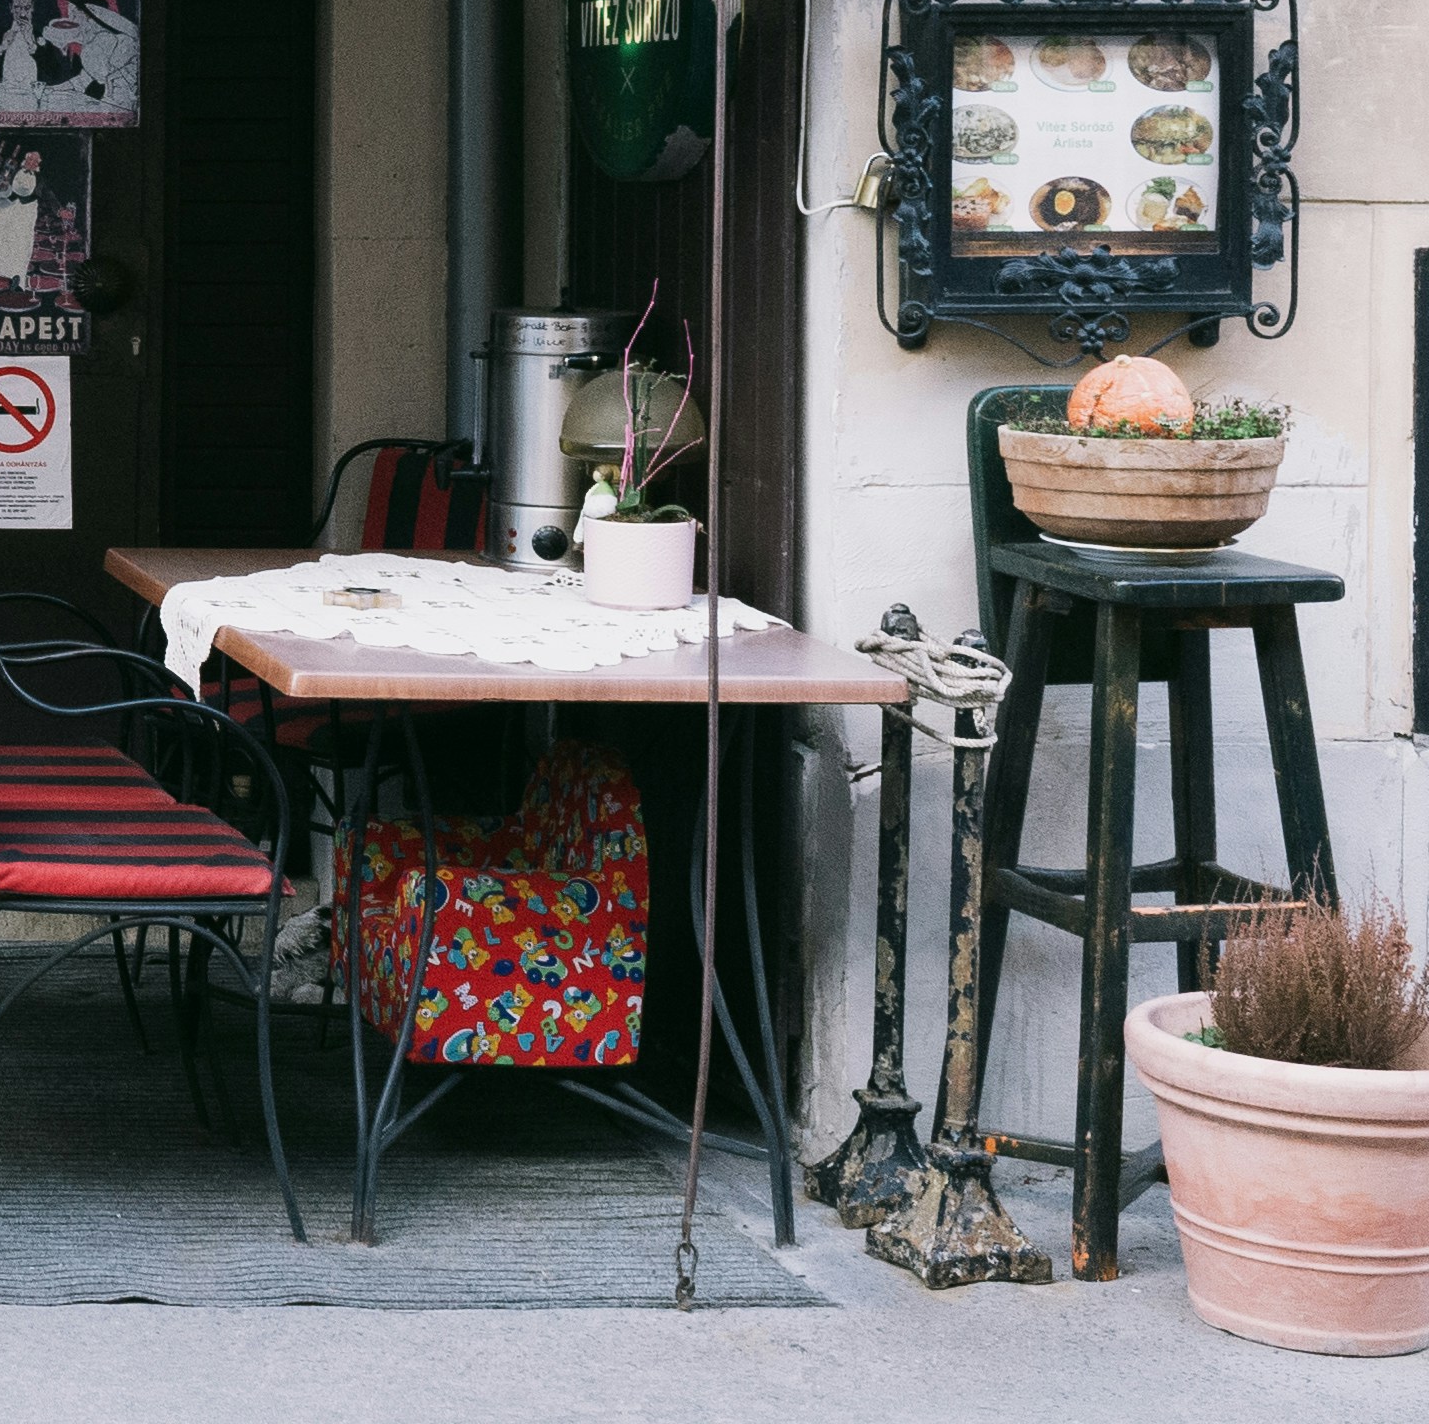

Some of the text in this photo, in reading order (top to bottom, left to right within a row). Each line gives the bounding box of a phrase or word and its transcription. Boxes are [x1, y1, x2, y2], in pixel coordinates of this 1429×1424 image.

[1037, 121, 1067, 132] Vitéz
[1053, 135, 1093, 149] Árlista
[33, 343, 59, 352] GOOD
[62, 342, 83, 352] DAY
